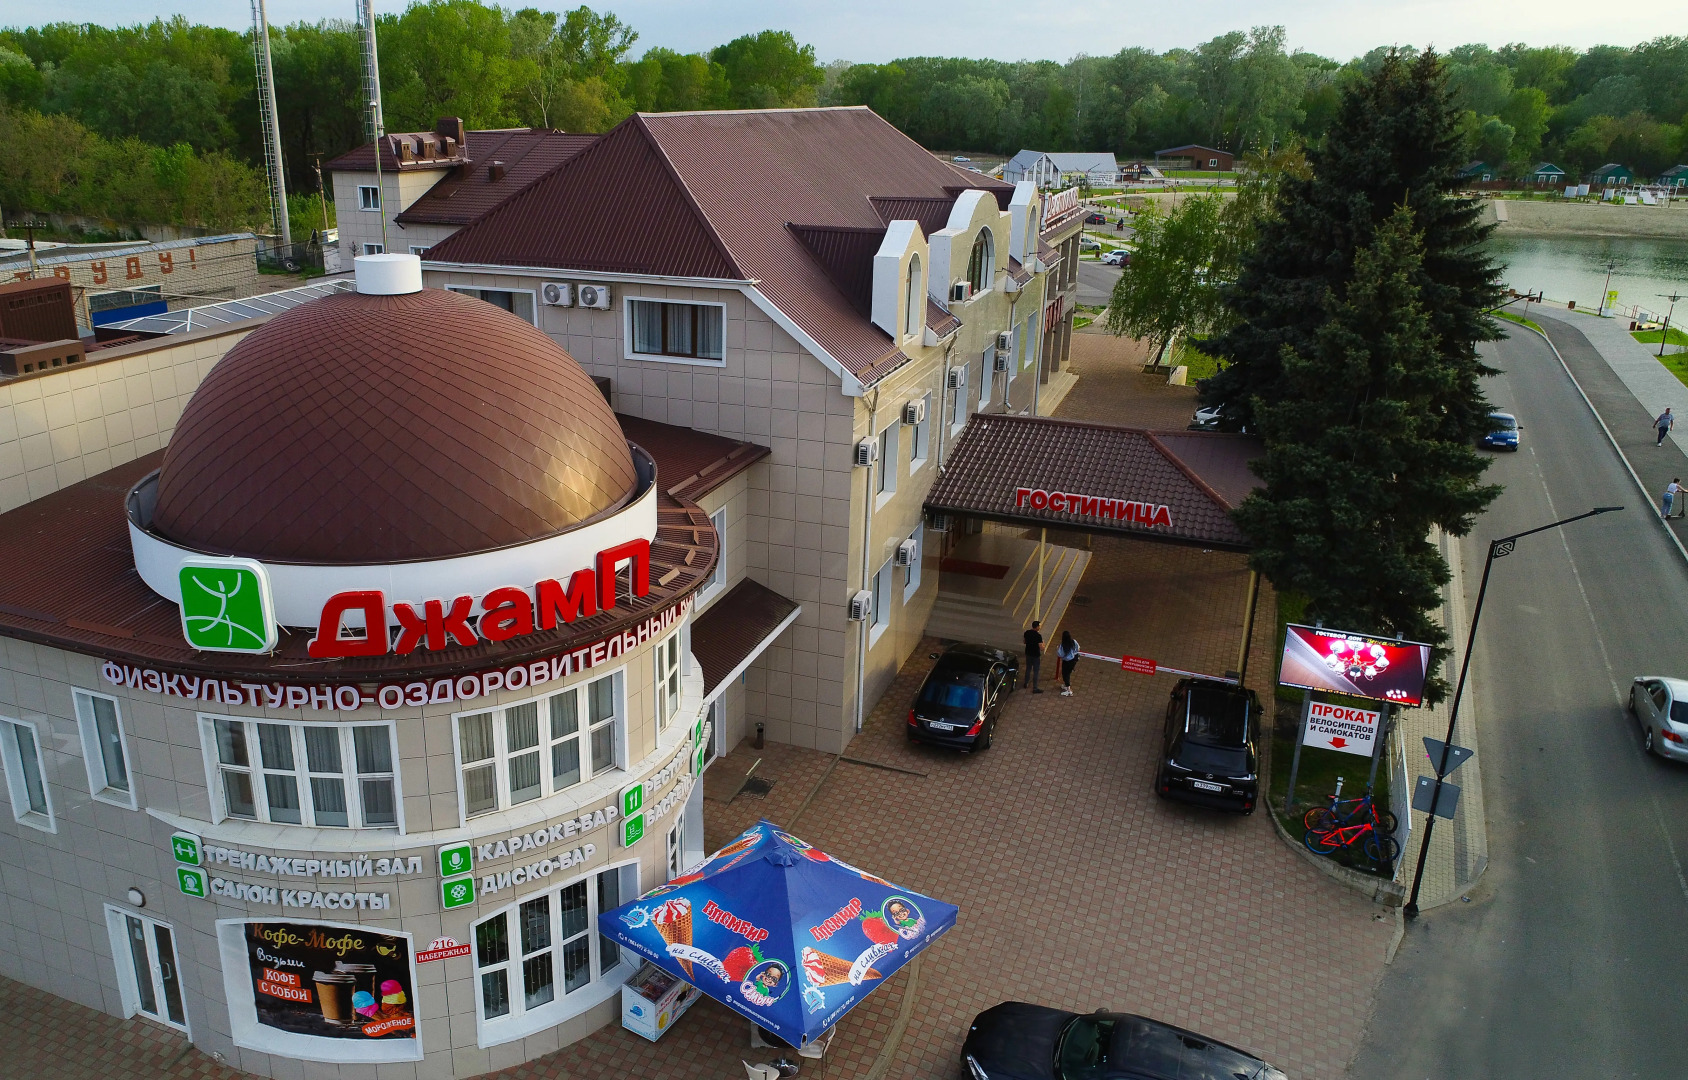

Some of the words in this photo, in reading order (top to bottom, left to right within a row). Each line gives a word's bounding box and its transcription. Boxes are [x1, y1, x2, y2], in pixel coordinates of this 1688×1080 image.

[1015, 486, 1173, 528] ГОСТИНИЦА
[101, 603, 677, 712] ФИЗКУЛЬТУРНО-ОЗДОРОВИТЕЛЬНЫЙ
[1309, 717, 1374, 734] ВЕЛОСИПЕДОВ
[1311, 704, 1377, 725] ПРОКАТ
[1309, 724, 1317, 732] И
[1318, 726, 1371, 741] САМОКАТОВ
[476, 805, 619, 863] КАРАОКЕ-БАР
[202, 844, 373, 878] ТРЕНАЖЕРНЫЙ
[375, 855, 423, 876] ЗАЛ
[480, 843, 597, 897] ДИСКО-БАР
[209, 877, 280, 906] САЛОН
[280, 889, 391, 911] КРАСОТЫ
[702, 899, 769, 943] ПЛОМБИР
[809, 897, 863, 942] ПЛОМБИР
[418, 946, 469, 962] НАБЕРЕЖНАЯ
[432, 938, 454, 950] 216
[256, 947, 306, 970] Возьми
[265, 969, 296, 985] КОФЕ
[261, 982, 269, 992] С
[270, 985, 309, 1001] СОБОЙ
[364, 1017, 412, 1035] МОРОЖЕНОЕ
